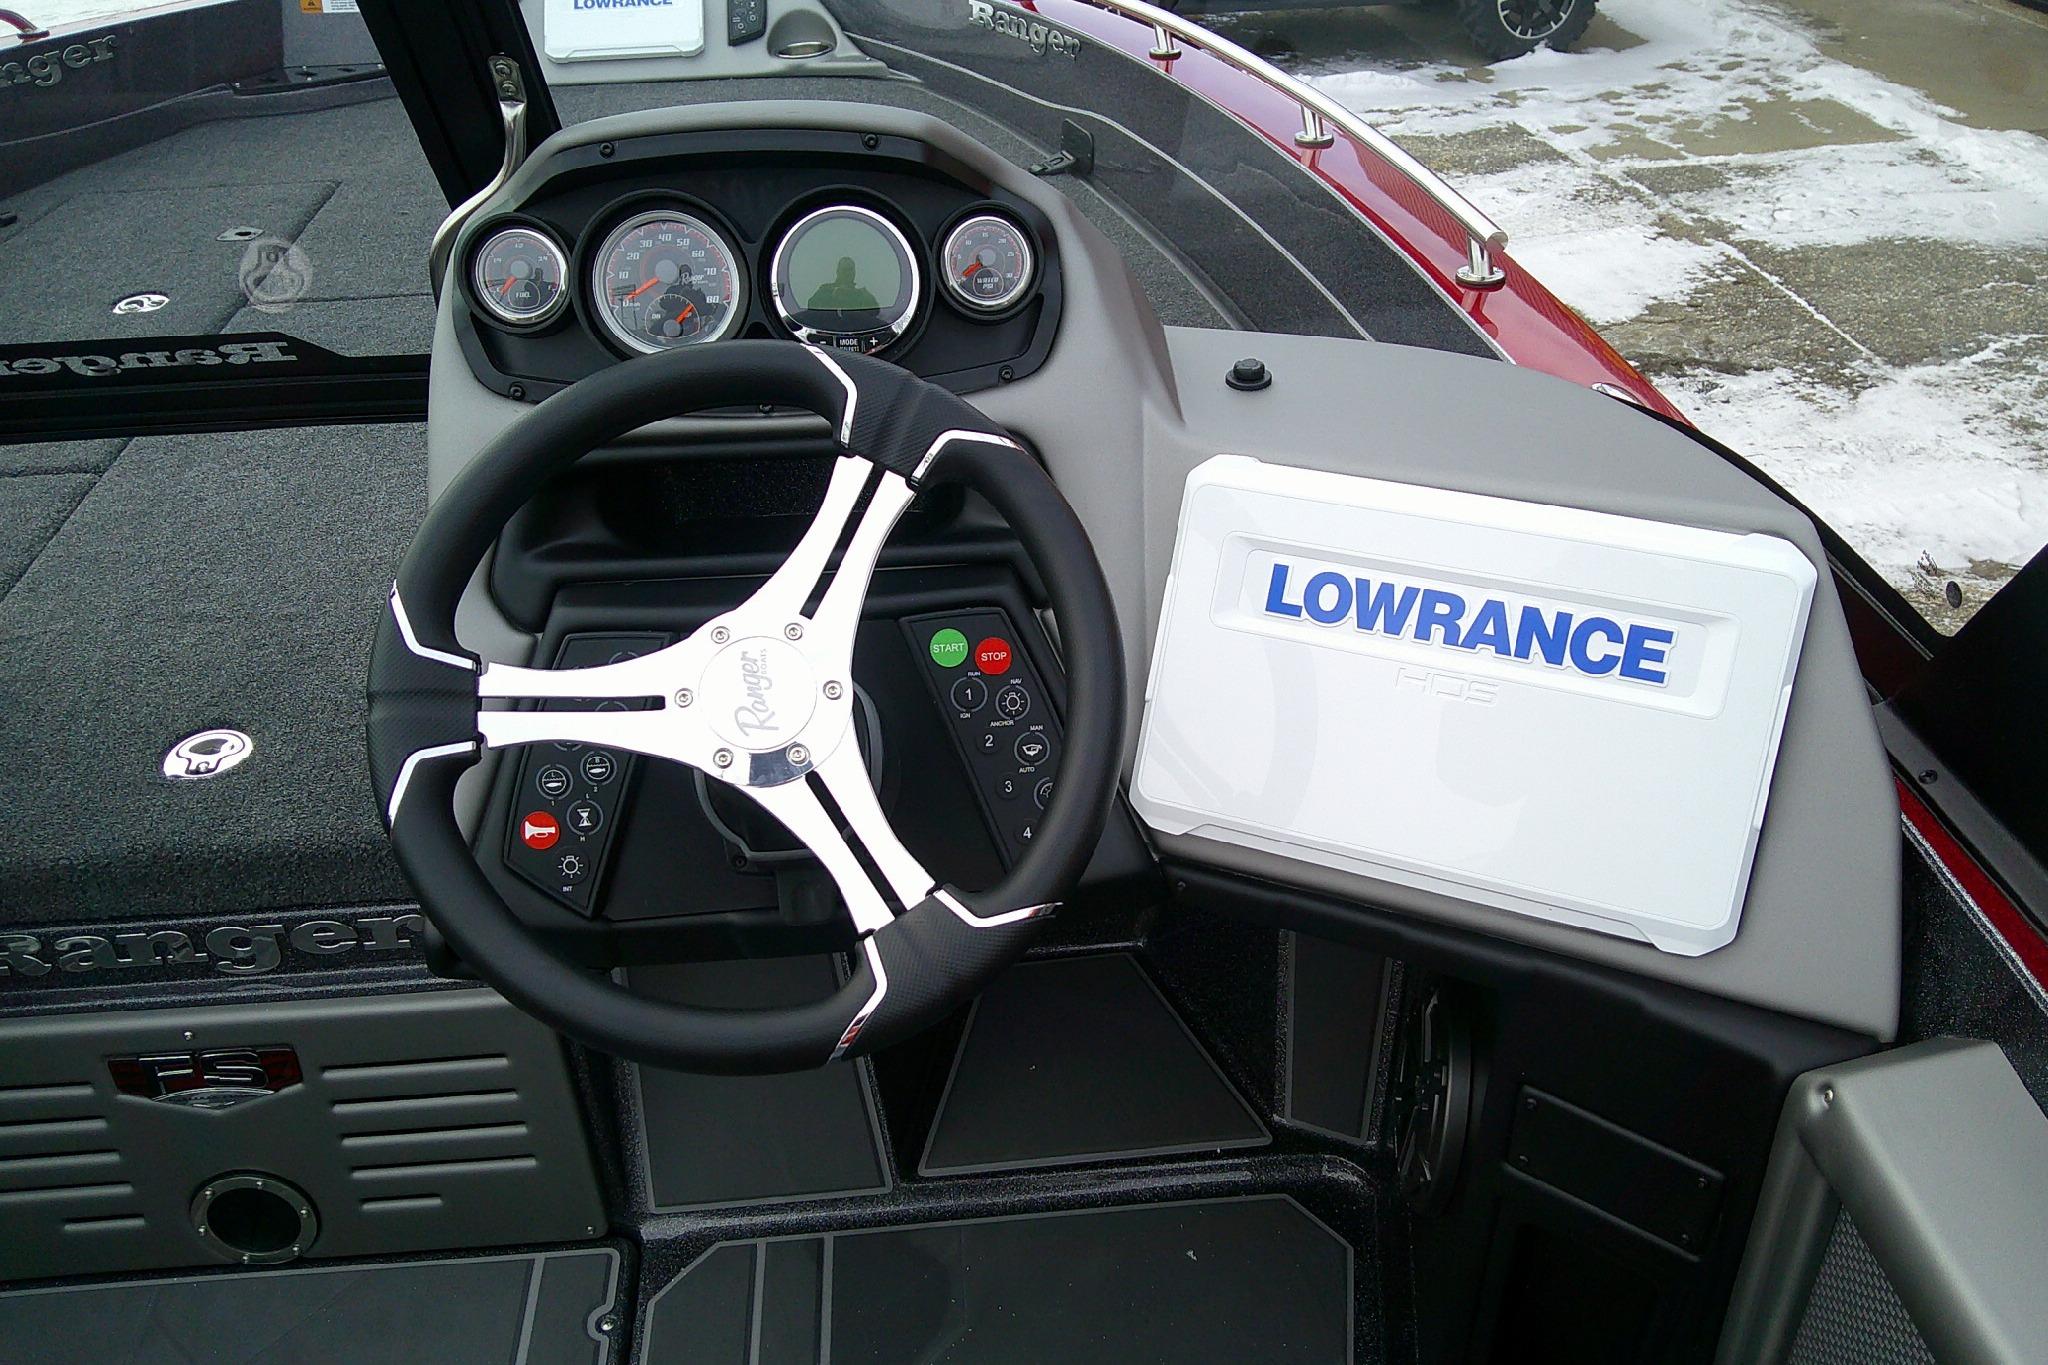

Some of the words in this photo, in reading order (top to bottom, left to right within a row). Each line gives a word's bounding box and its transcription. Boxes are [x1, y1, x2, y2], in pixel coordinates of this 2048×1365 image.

[968, 0, 1081, 57] Ranger
[658, 233, 672, 242] 40
[639, 239, 653, 248] 30
[676, 238, 690, 247] 50
[626, 252, 640, 260] 20
[691, 250, 705, 258] 60
[619, 271, 629, 279] 10
[704, 267, 717, 275] 70
[706, 295, 720, 304] 80
[839, 338, 858, 346] MODE
[1264, 563, 1675, 684] LOWRANCE
[933, 642, 965, 653] START
[981, 652, 1007, 662] STOP
[734, 650, 780, 737] Ranger
[965, 688, 972, 701] 1
[990, 720, 1015, 728] ANCHOR
[985, 734, 994, 747] 2
[1018, 766, 1035, 774] AUTO
[1004, 780, 1013, 793] 3
[1023, 826, 1032, 839] 4
